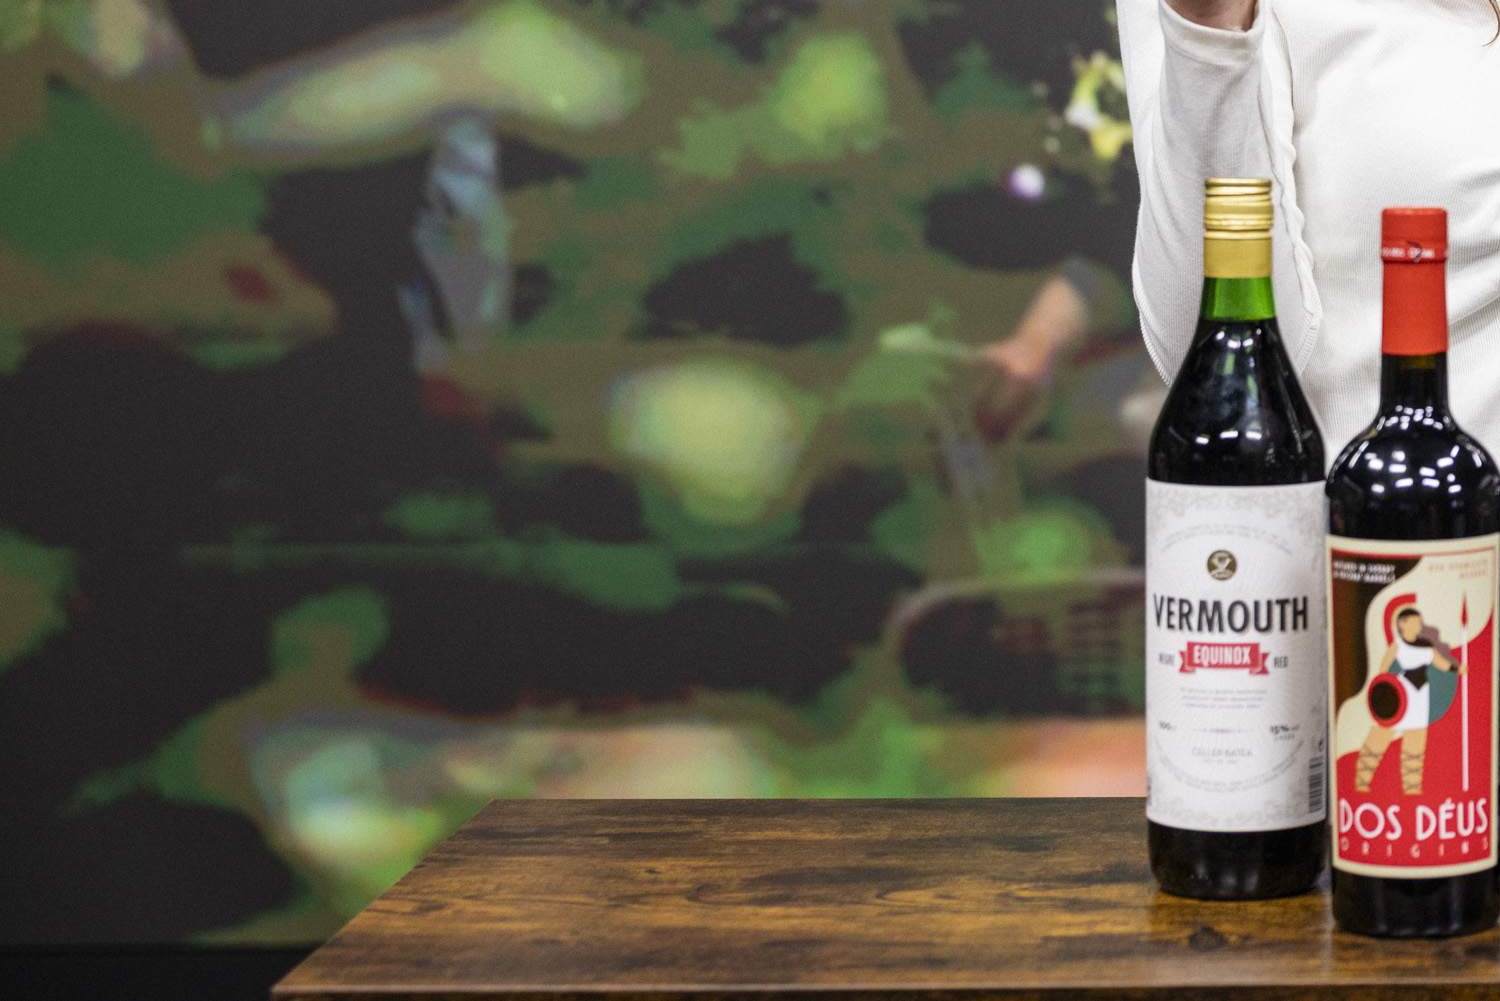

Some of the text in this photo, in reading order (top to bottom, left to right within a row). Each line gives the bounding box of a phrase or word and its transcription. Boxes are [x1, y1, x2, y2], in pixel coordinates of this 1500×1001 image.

[1153, 593, 1309, 633] VERMOUTH
[1193, 645, 1252, 667] EQUINOX
[1339, 797, 1489, 841] DOS DÉUS
[1340, 836, 1489, 859] ORIGINS
